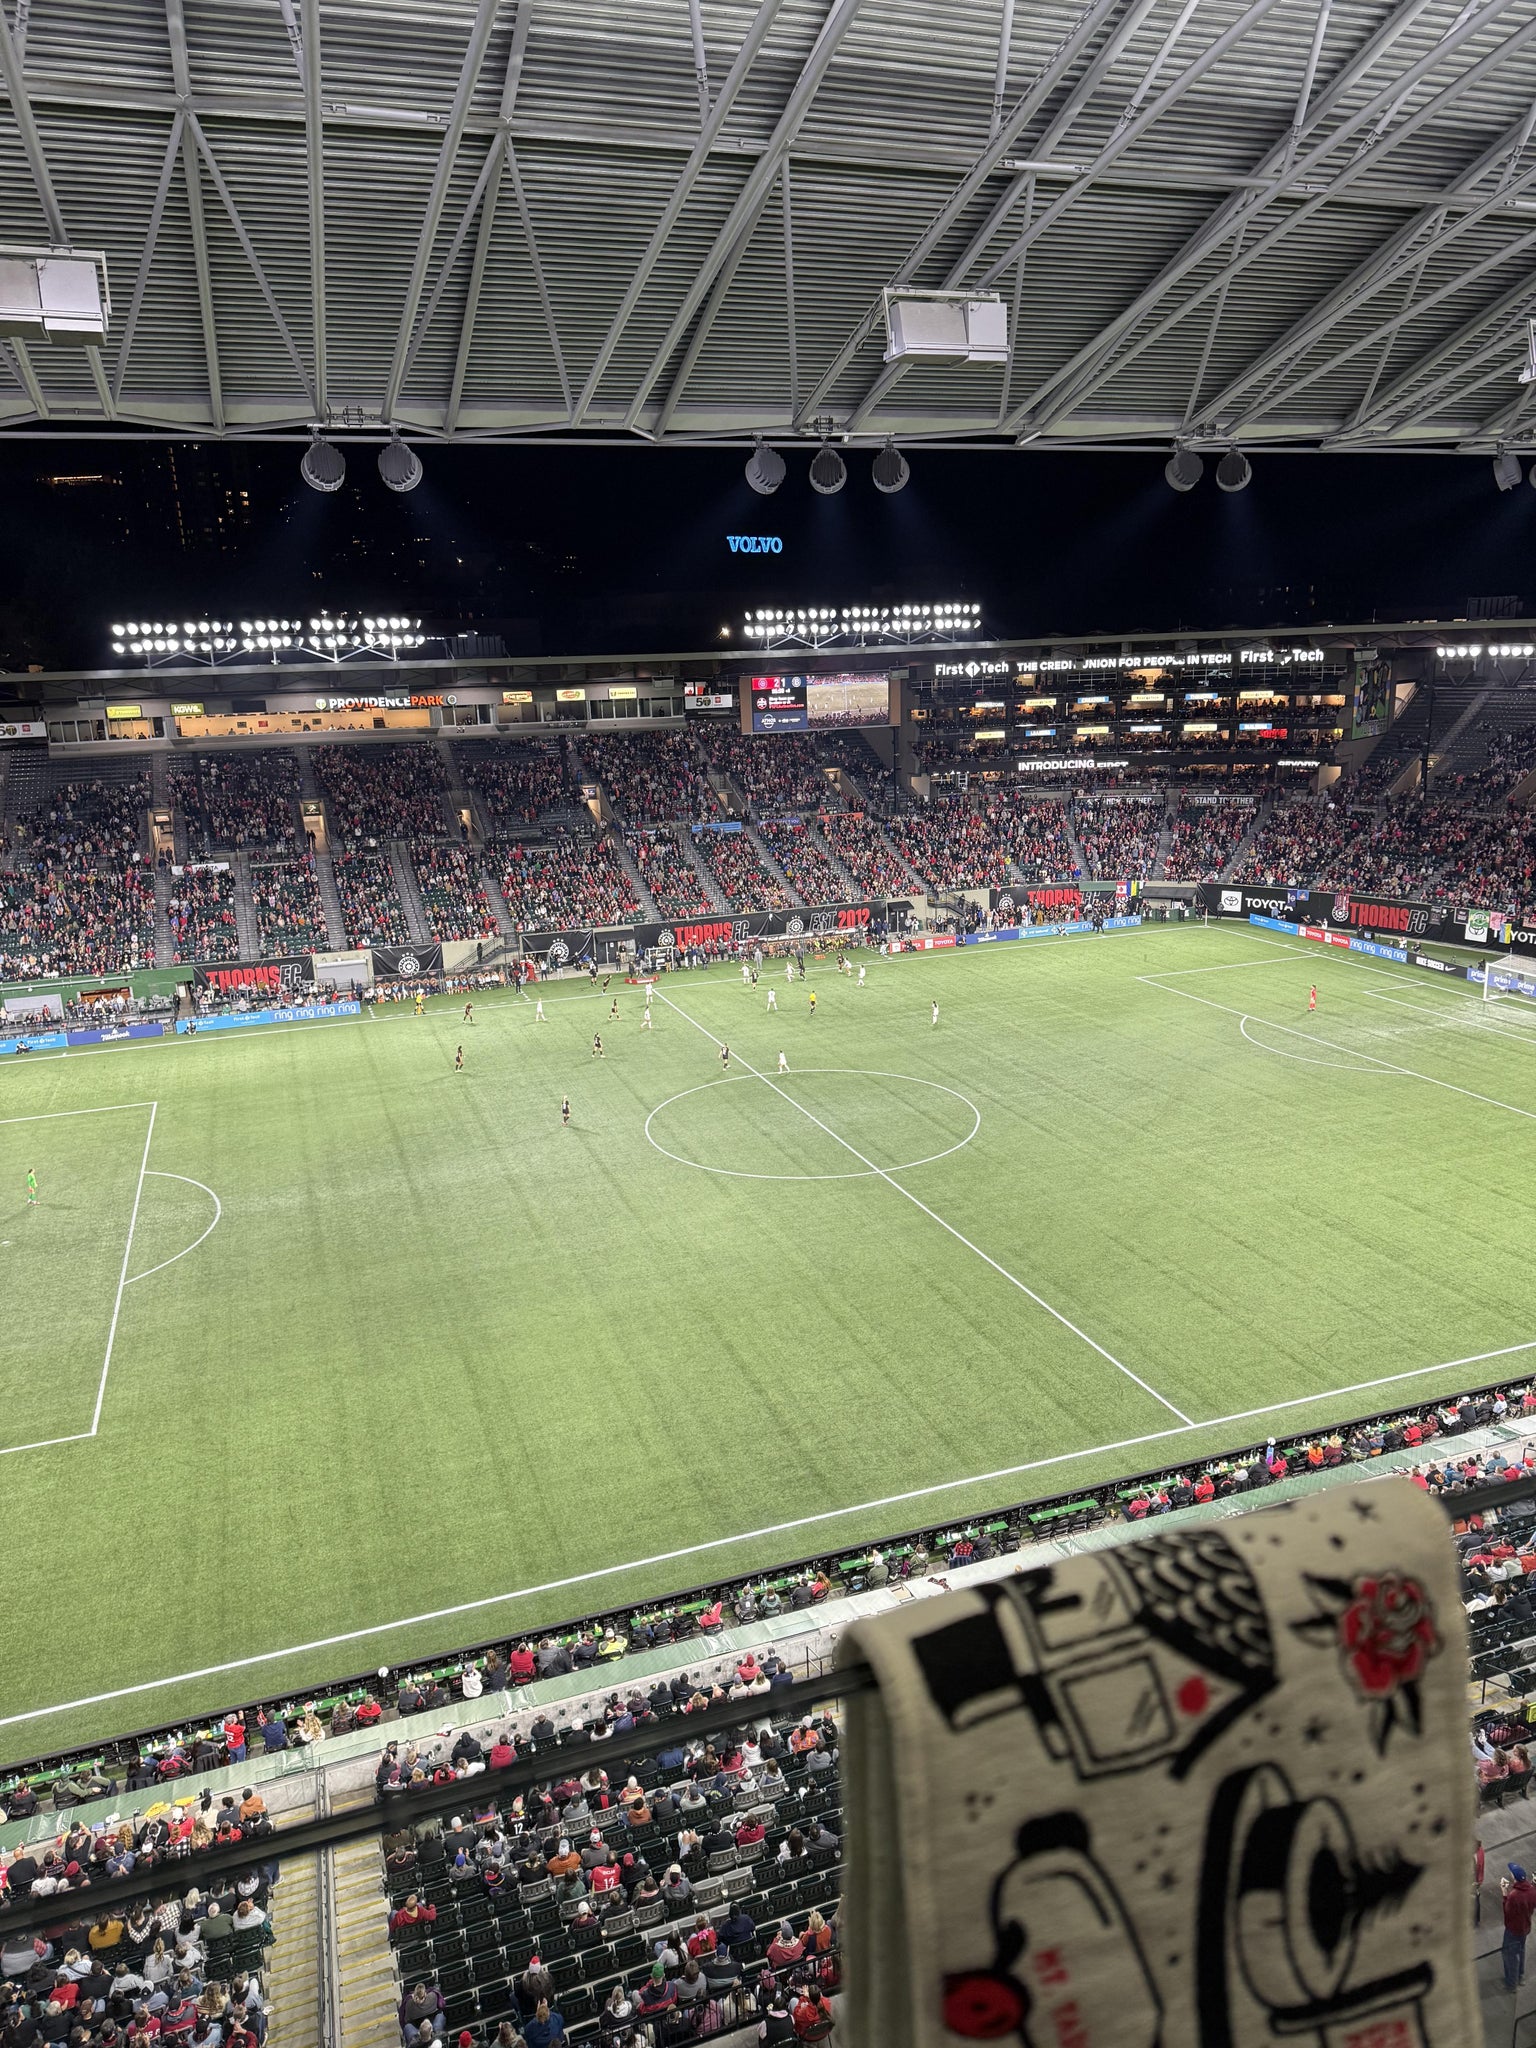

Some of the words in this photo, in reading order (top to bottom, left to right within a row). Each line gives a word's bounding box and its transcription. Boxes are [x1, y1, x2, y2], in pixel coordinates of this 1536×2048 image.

[726, 536, 783, 553] VOLVO
[1017, 662, 1038, 672] THE
[1119, 657, 1141, 668] FOR
[1187, 654, 1200, 665] IN
[1201, 653, 1232, 664] TECH
[1240, 650, 1274, 664] First
[1292, 648, 1324, 662] Tech
[935, 663, 964, 676] First
[980, 661, 1009, 674] Tech
[1018, 760, 1095, 771] INTRODUCING
[1350, 940, 1363, 950] ring
[1363, 943, 1376, 954] ring
[1380, 947, 1393, 958] ring
[1393, 951, 1407, 963] ring
[1517, 981, 1535, 991] prime
[274, 1010, 294, 1021] ring
[295, 1008, 315, 1019] ring
[317, 1005, 336, 1017] ring
[339, 1003, 356, 1014] ring
[513, 1822, 524, 1835] 12
[603, 1877, 615, 1891] 12
